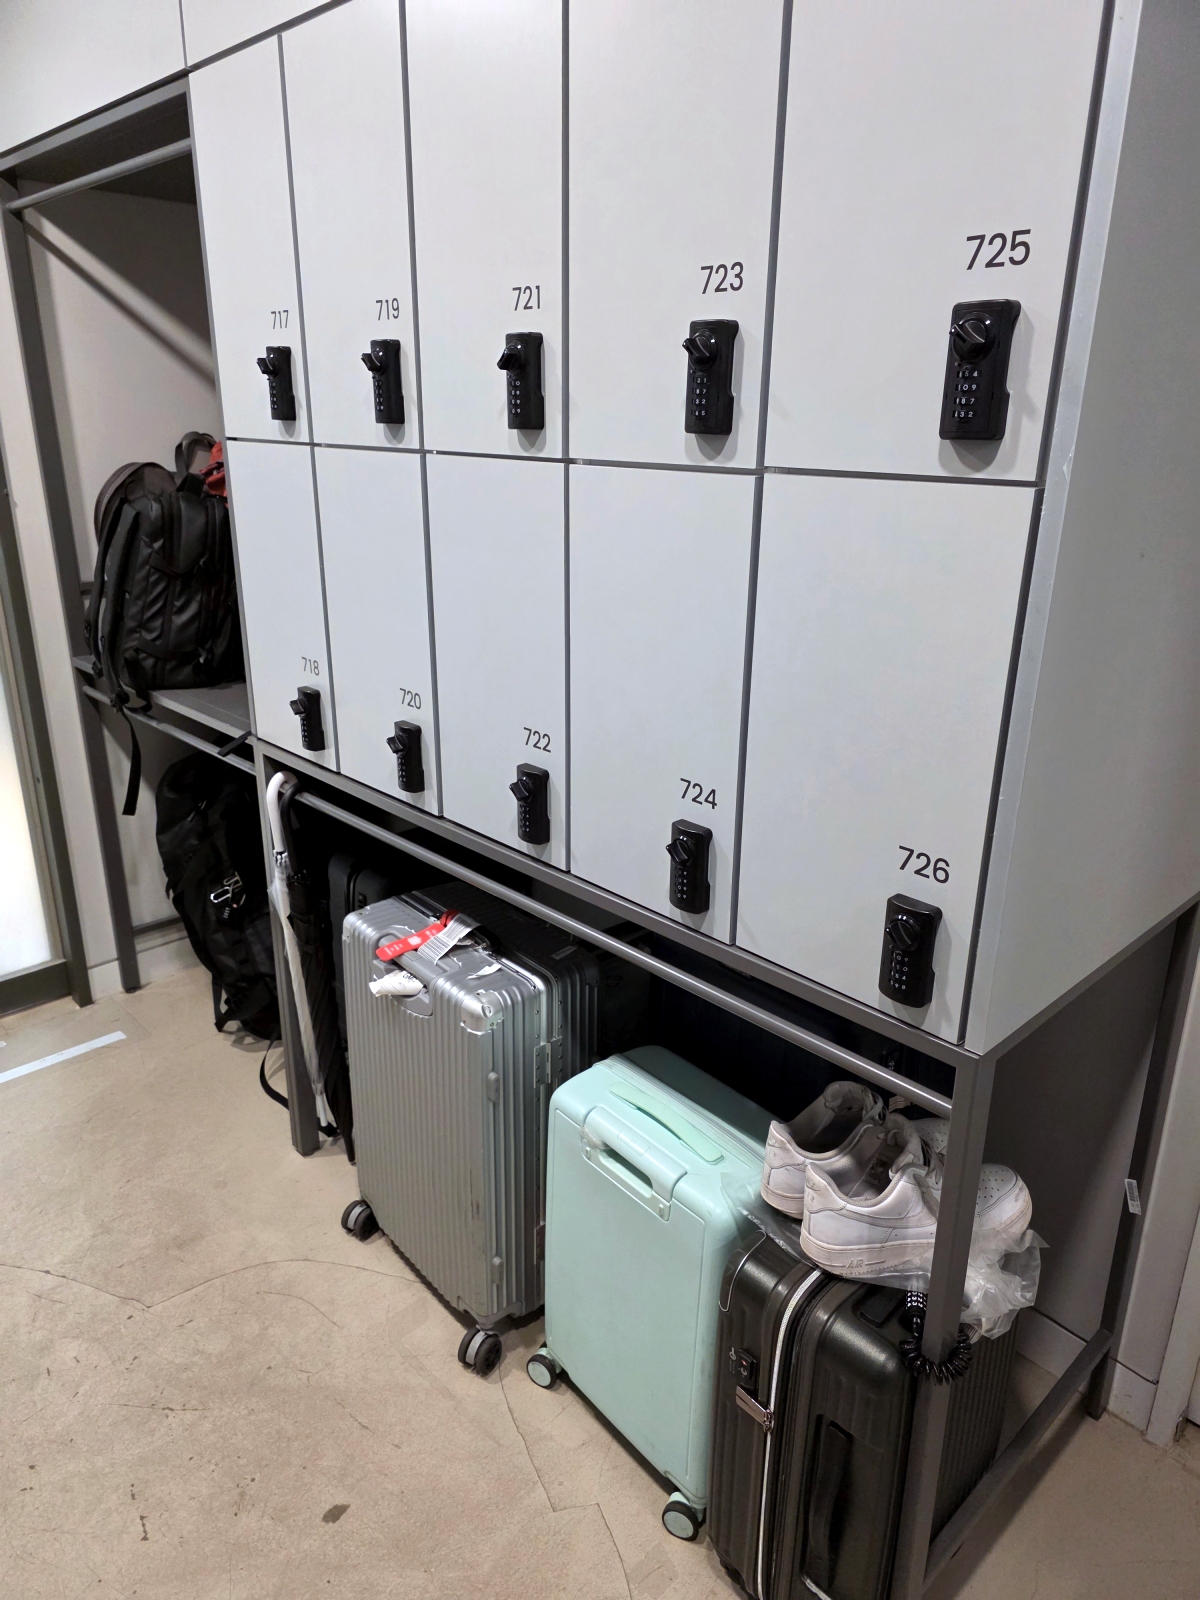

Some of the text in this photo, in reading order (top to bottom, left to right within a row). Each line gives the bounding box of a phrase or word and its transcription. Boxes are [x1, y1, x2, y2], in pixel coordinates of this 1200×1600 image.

[966, 229, 1032, 270] 725
[700, 262, 743, 295] 723
[375, 298, 400, 321] 719
[512, 285, 540, 312] 721
[270, 310, 289, 330] 717
[302, 656, 320, 677] 718
[399, 687, 421, 710] 720
[524, 727, 552, 754] 722
[680, 778, 717, 810] 724
[898, 844, 951, 884] 726
[847, 1257, 864, 1270] AIR
